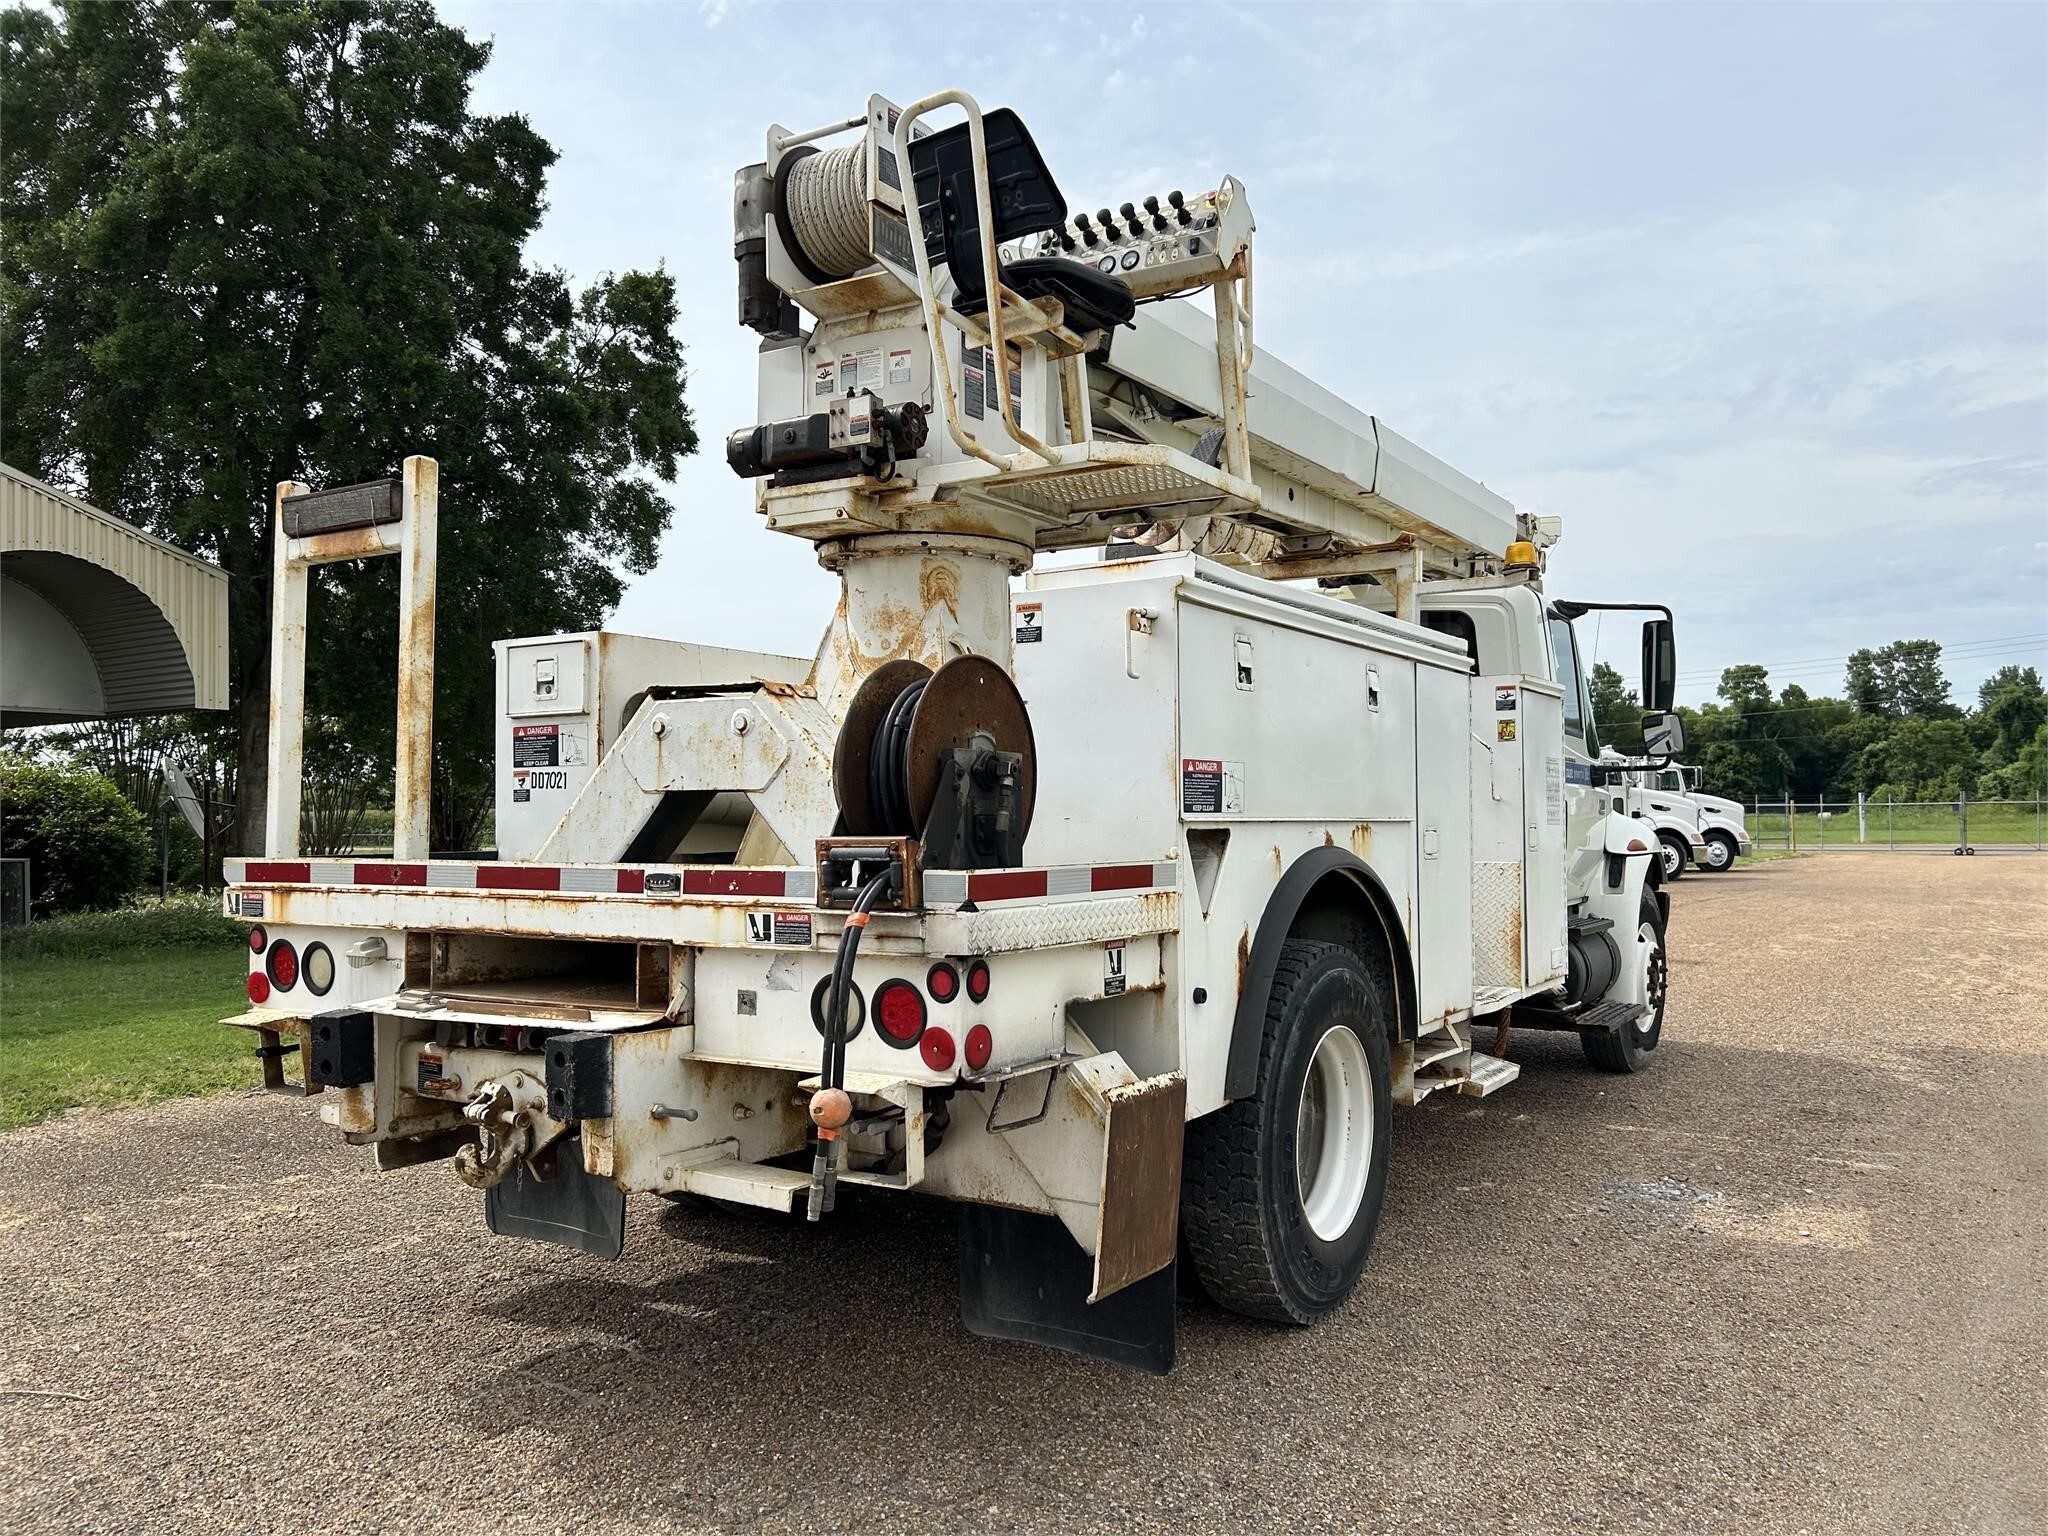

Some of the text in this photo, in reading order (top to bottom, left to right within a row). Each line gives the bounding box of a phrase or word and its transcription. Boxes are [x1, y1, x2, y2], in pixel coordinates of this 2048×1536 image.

[527, 726, 553, 735] DANGER
[1195, 761, 1218, 771] DANGER
[531, 771, 567, 789] DD7021
[786, 913, 809, 921] DANGER
